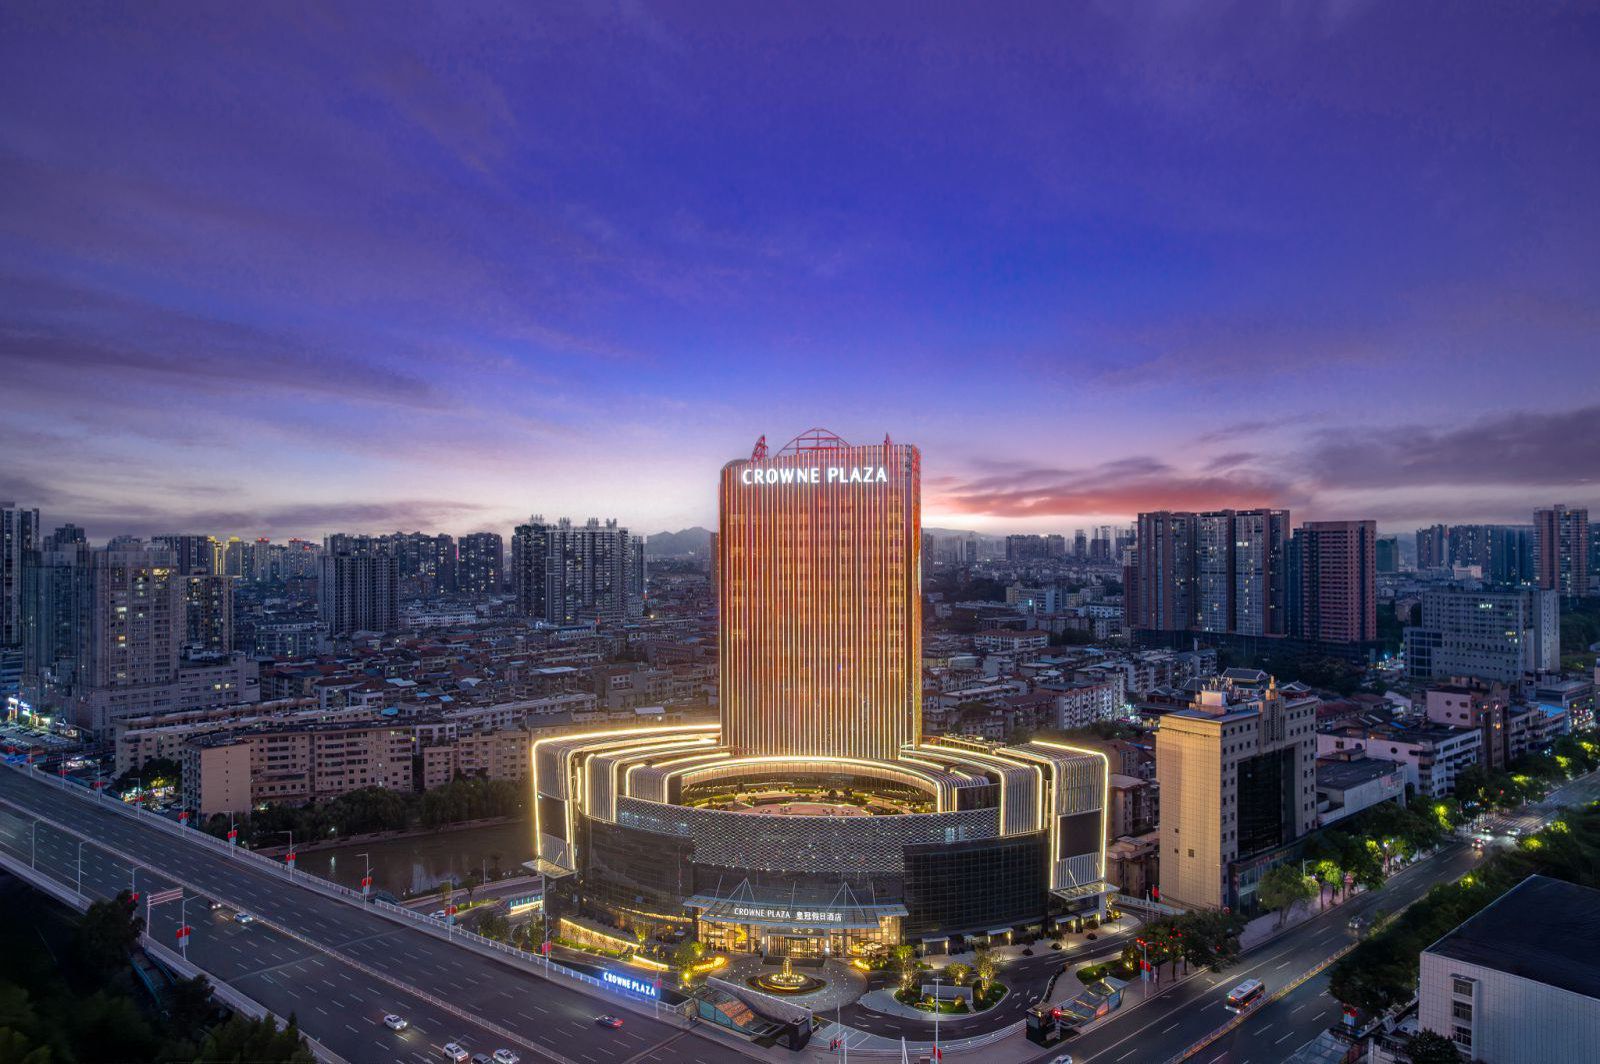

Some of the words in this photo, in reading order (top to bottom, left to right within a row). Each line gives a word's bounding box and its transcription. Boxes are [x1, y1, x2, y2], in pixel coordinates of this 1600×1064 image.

[742, 467, 820, 484] CROWNE
[827, 466, 888, 483] PLAZA
[734, 907, 765, 916] CROWNE
[767, 909, 791, 918] PLAZA
[796, 911, 842, 922] 皇冠假日酒店
[604, 972, 630, 988] CROWNE
[632, 981, 655, 996] PLAZA
